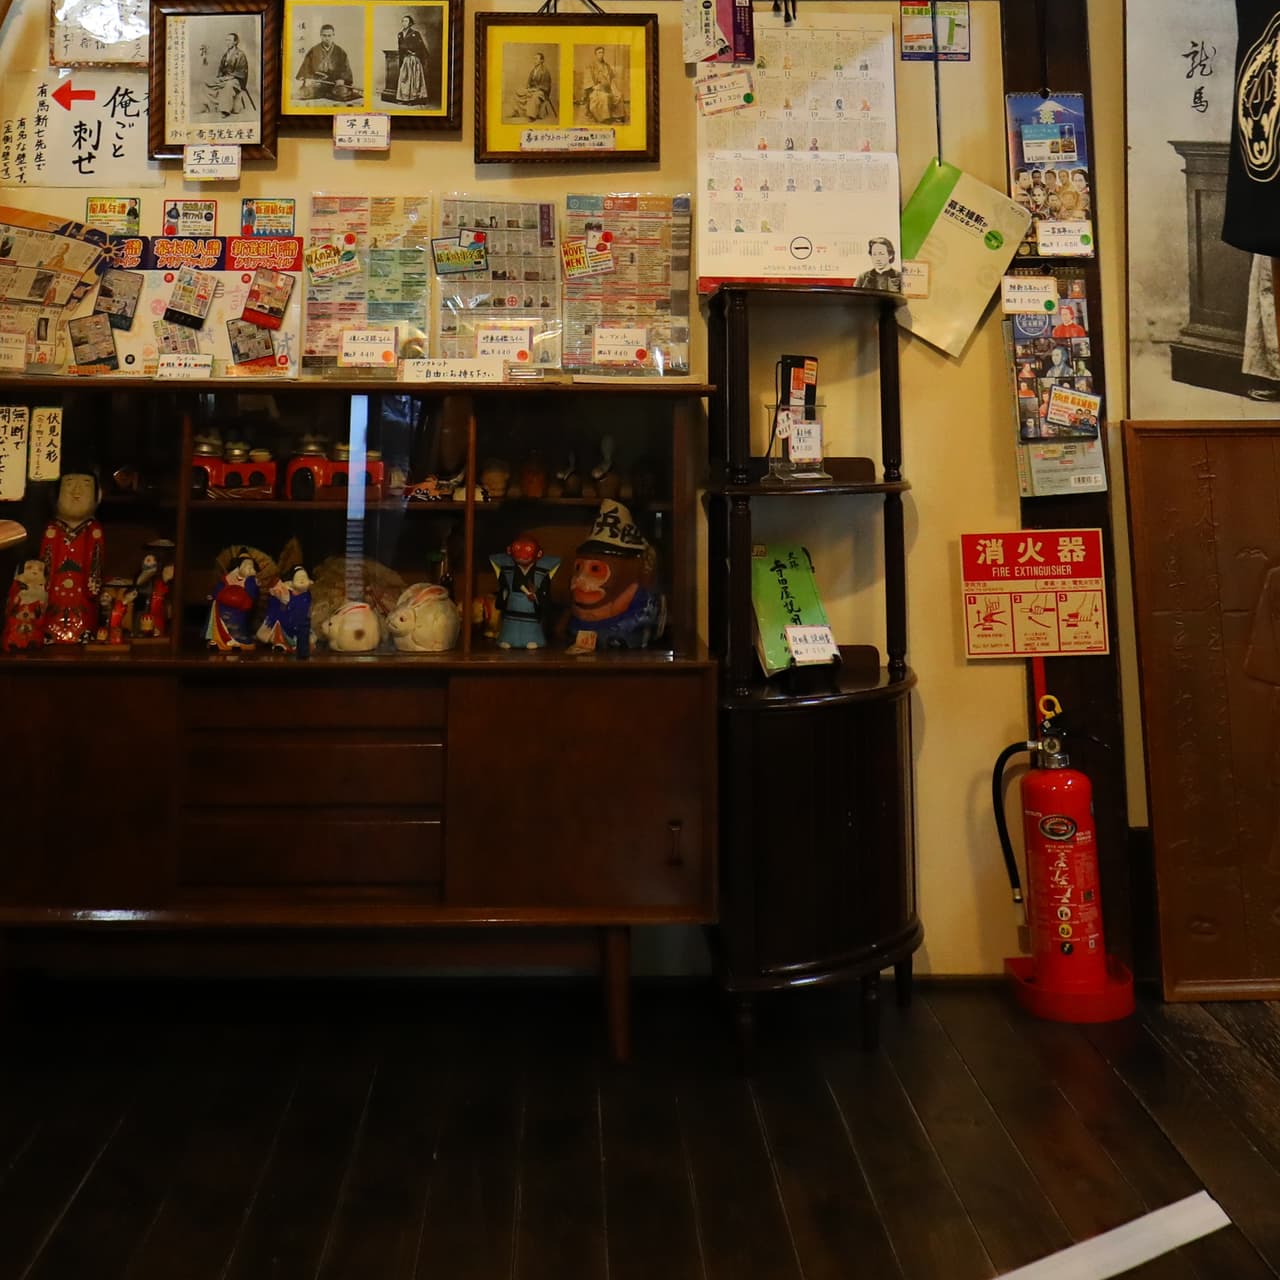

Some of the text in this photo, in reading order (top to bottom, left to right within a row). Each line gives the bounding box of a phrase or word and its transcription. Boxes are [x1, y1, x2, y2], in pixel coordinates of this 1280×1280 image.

[1181, 40, 1217, 114] 龍馬
[34, 81, 49, 171] 有馬新七先生で
[103, 85, 141, 158] 俺ごと
[346, 117, 372, 130] 写真
[71, 119, 103, 176] 刺せ
[231, 238, 298, 258] 新選組年譜
[563, 246, 584, 257] MOVE
[158, 255, 218, 269] クリアファイル
[234, 255, 296, 270] クリアファイル
[415, 368, 495, 379] ご自由にお持ち下さい
[10, 408, 27, 451] 無断で
[46, 412, 61, 464] 伏見人形
[975, 536, 1087, 565] 消火器
[992, 564, 1073, 577] FIRE EXTINGUISHER
